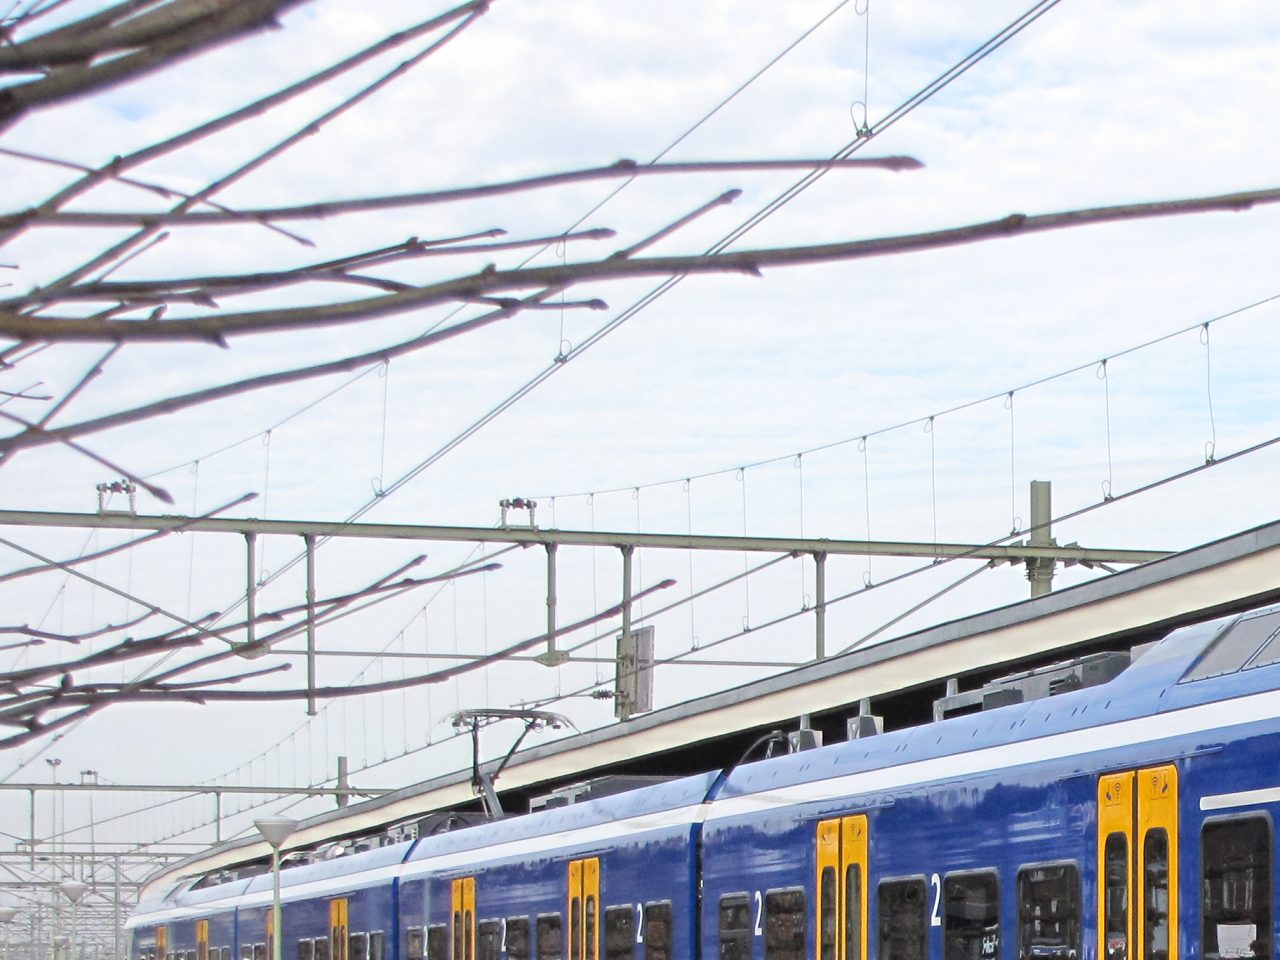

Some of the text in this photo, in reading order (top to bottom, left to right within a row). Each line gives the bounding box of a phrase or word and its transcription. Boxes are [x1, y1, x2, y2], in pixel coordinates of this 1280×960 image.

[755, 890, 763, 935] 2
[931, 873, 941, 927] 2
[637, 903, 643, 943] 2
